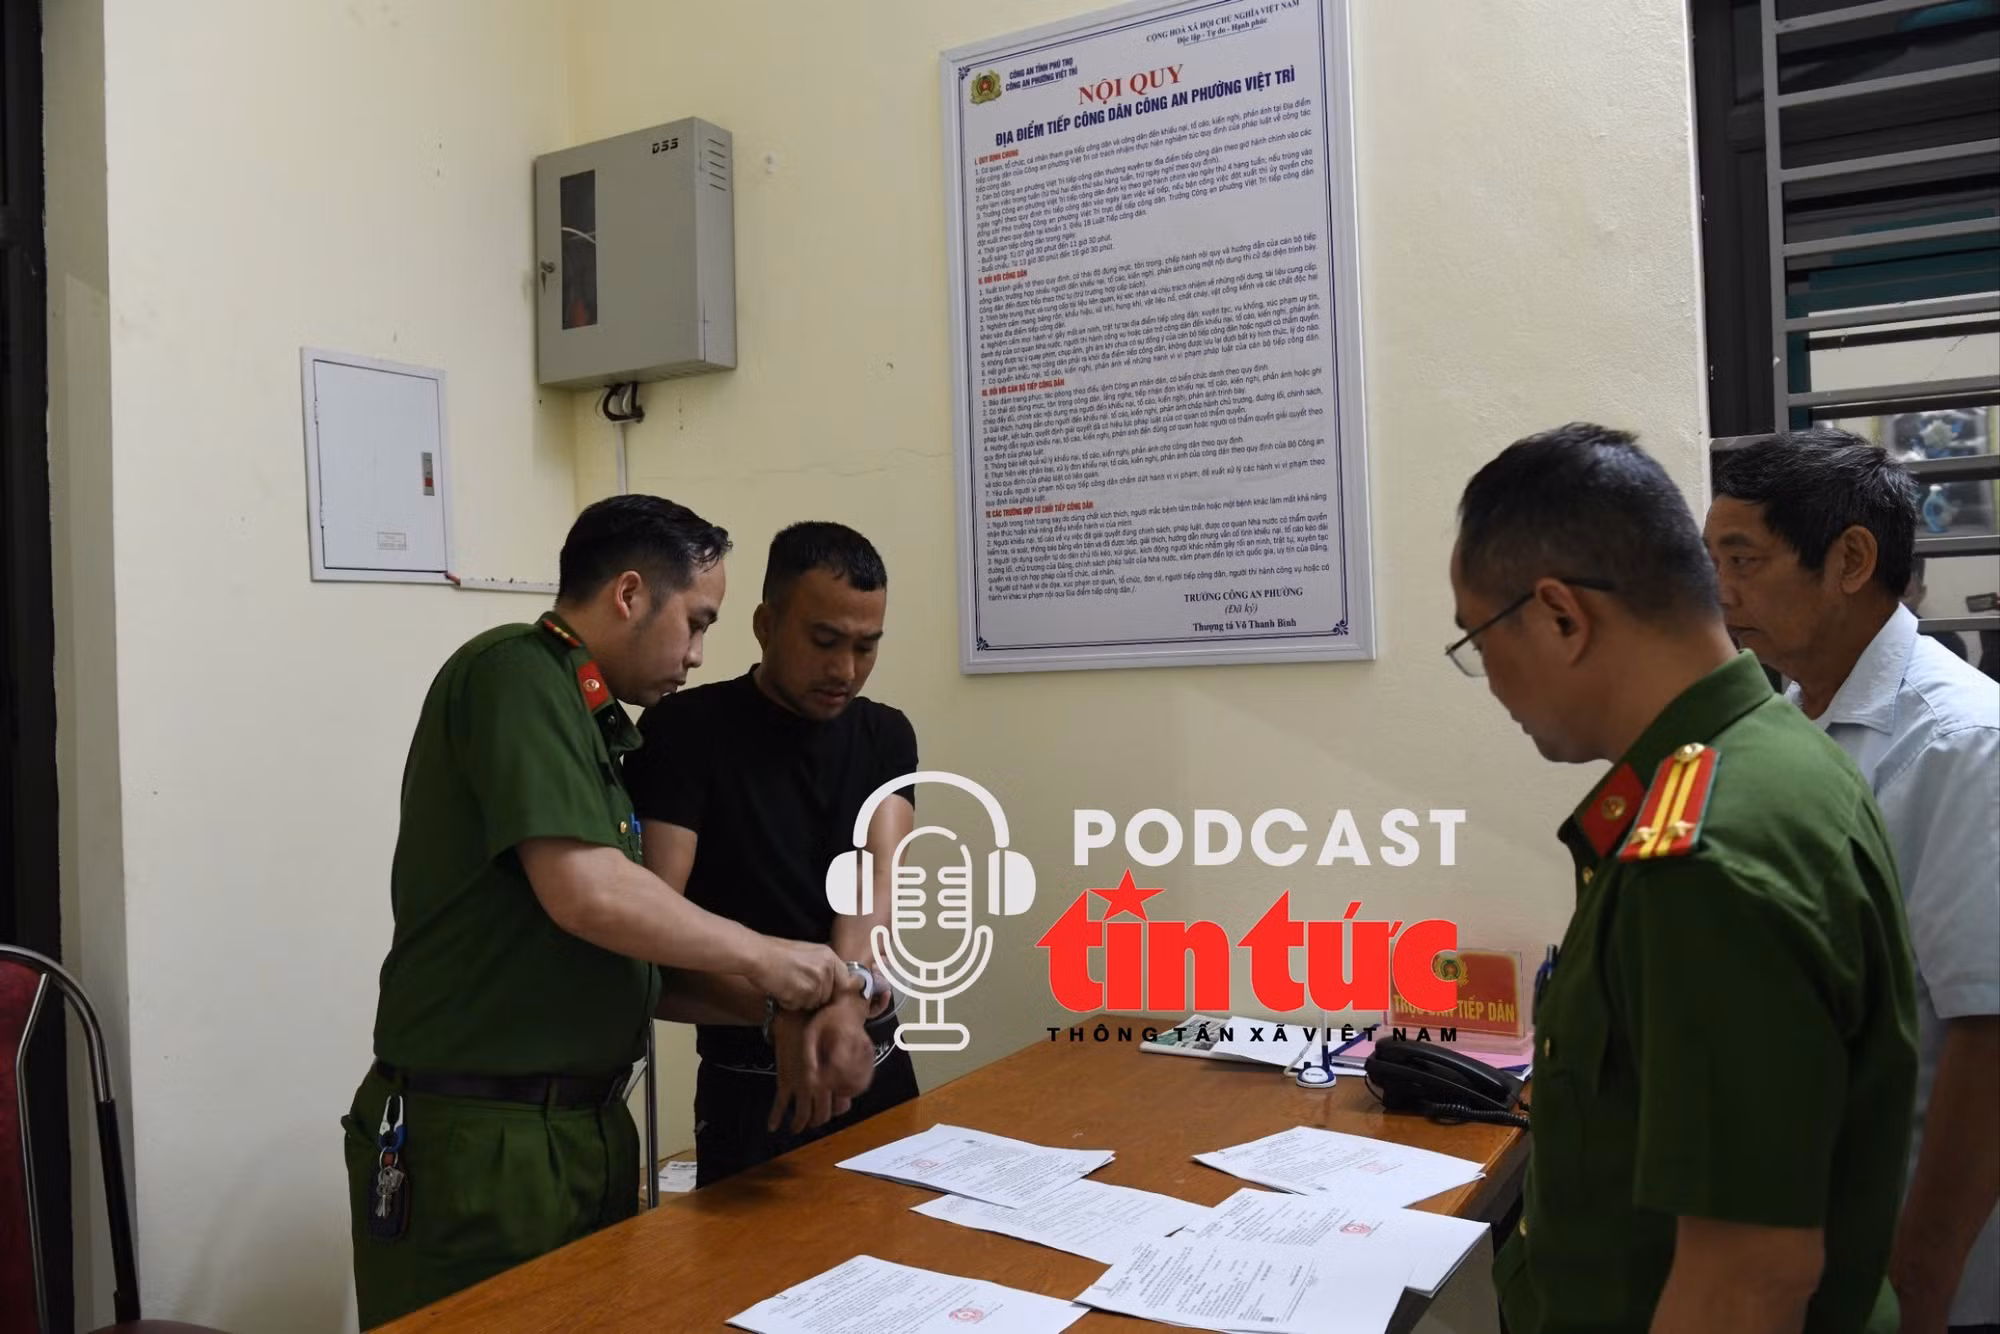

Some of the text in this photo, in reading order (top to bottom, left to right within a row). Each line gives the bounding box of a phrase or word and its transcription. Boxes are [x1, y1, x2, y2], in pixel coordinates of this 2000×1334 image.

[1025, 66, 1034, 76] AN
[1021, 78, 1030, 87] AN
[1078, 63, 1183, 105] NỘI QUY
[995, 64, 1295, 148] ĐỊA ĐIỂM TIẾP CÔNG DÂN CÔNG AN PHƯỜNG VIỆT TRÌ
[1222, 588, 1248, 601] CÔNG
[1249, 590, 1262, 599] AN
[1248, 618, 1275, 629] Thanh
[1458, 995, 1485, 1019] TIẾP
[1487, 999, 1515, 1022] DÂN
